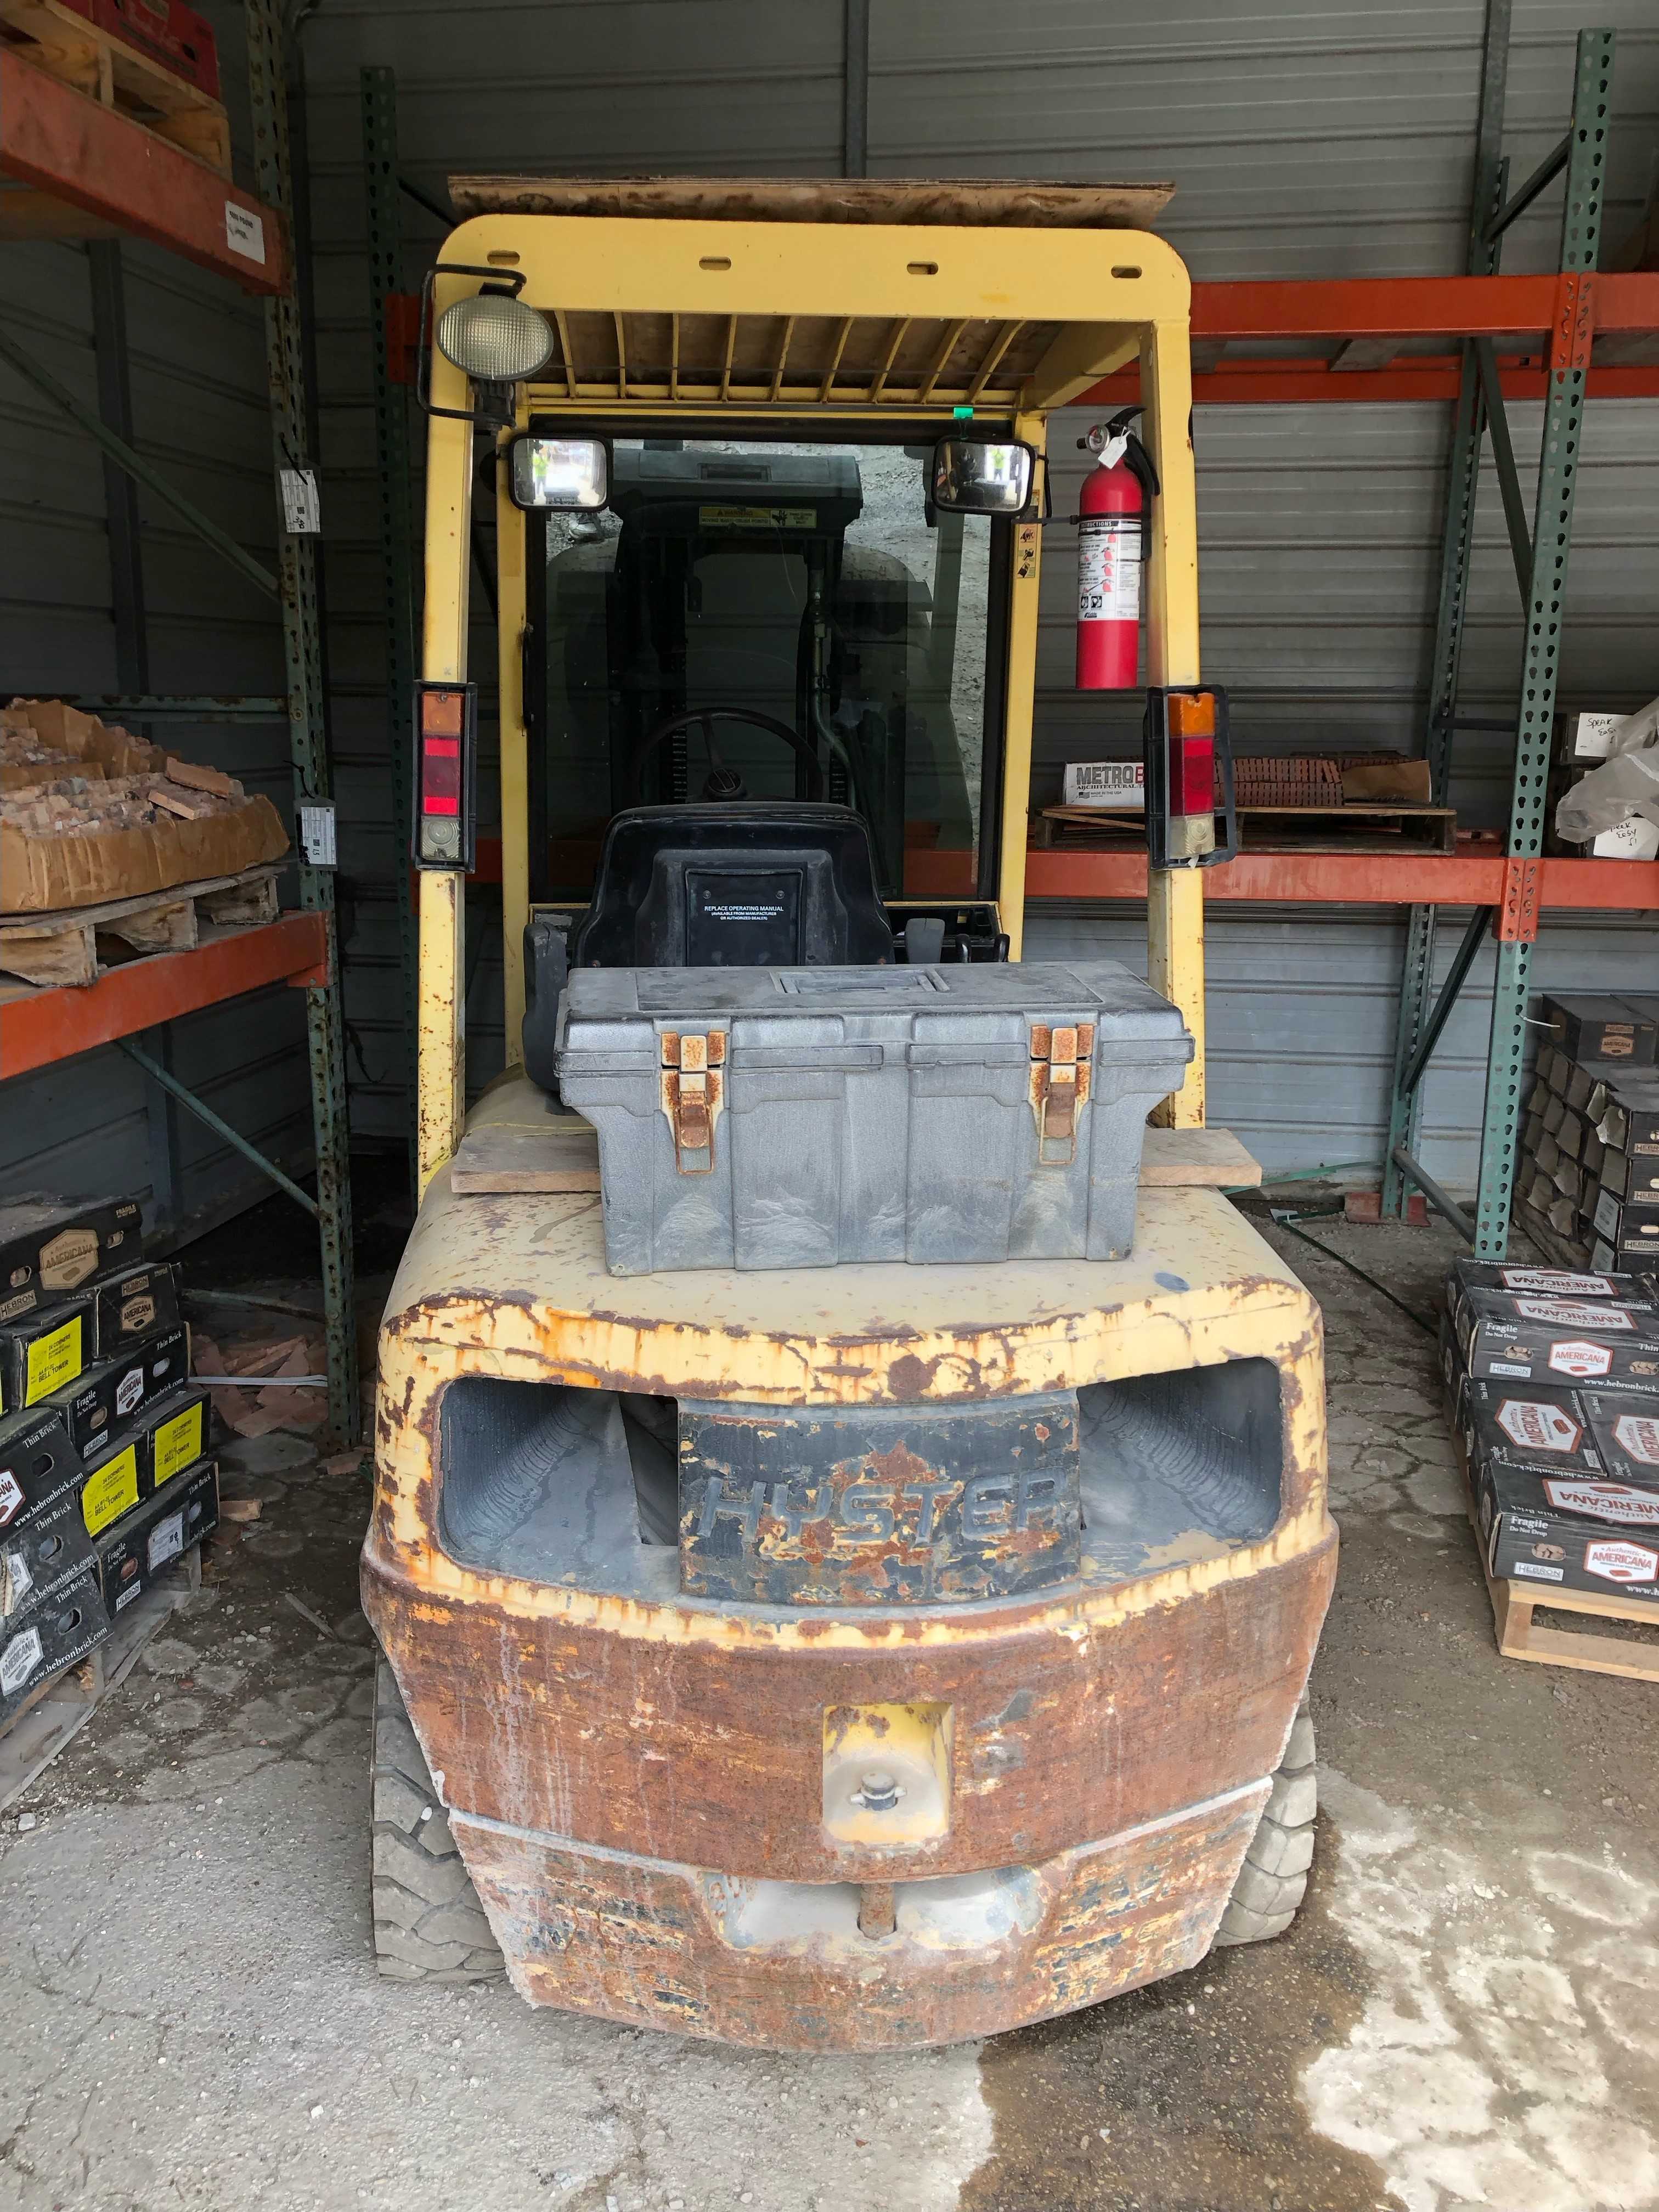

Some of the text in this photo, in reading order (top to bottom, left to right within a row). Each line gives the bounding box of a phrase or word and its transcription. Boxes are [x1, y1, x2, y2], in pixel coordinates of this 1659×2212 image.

[1076, 766, 1144, 785] METROB
[46, 1244, 93, 1269] AMERICANA
[1513, 1277, 1604, 1289] AMERICANA
[1, 1293, 36, 1317] HEBRON
[124, 1304, 151, 1321] AMERICANA
[1527, 1306, 1623, 1323] AMERICANA
[1487, 1322, 1518, 1334] Fragile
[156, 1330, 182, 1351] Thin Brick
[1555, 1351, 1605, 1364] AMERICANA
[38, 1359, 69, 1383] BELL TOWER
[119, 1376, 142, 1403] AMERICANA
[134, 1377, 184, 1415] www.hebronbrick.com
[1584, 1379, 1659, 1393] www.hebronbrick.
[77, 1390, 96, 1409] Fragile
[22, 1421, 57, 1448] Thin Brick
[1520, 1406, 1549, 1446] AMERICANA
[164, 1455, 174, 1464] BELL
[1498, 1460, 1599, 1481] www.hebronbrick.com
[188, 1472, 211, 1496] Thin Brick
[14, 1472, 84, 1528] www.hebronbrick.com
[95, 1489, 125, 1516] BELL TOWER
[697, 1466, 1068, 1543] HYSTER
[1559, 1491, 1659, 1515] MERICANA
[35, 1512, 52, 1532] Thin
[52, 1502, 72, 1520] Brick
[1510, 1505, 1562, 1519] Thin Brick
[1587, 1505, 1654, 1520] Authentic
[1510, 1516, 1549, 1530] Fragile
[1531, 1528, 1548, 1537] Drop
[108, 1542, 127, 1564] Fragile
[1592, 1551, 1652, 1570] AMERICANA
[1605, 1546, 1641, 1556] Authentic
[1519, 1565, 1561, 1578] HEBRON
[55, 1575, 88, 1604] Thin Brick
[117, 1583, 140, 1609] HEBRON
[2, 1638, 36, 1679] AMERICANA
[29, 1626, 108, 1687] www.hebronbrick.com
